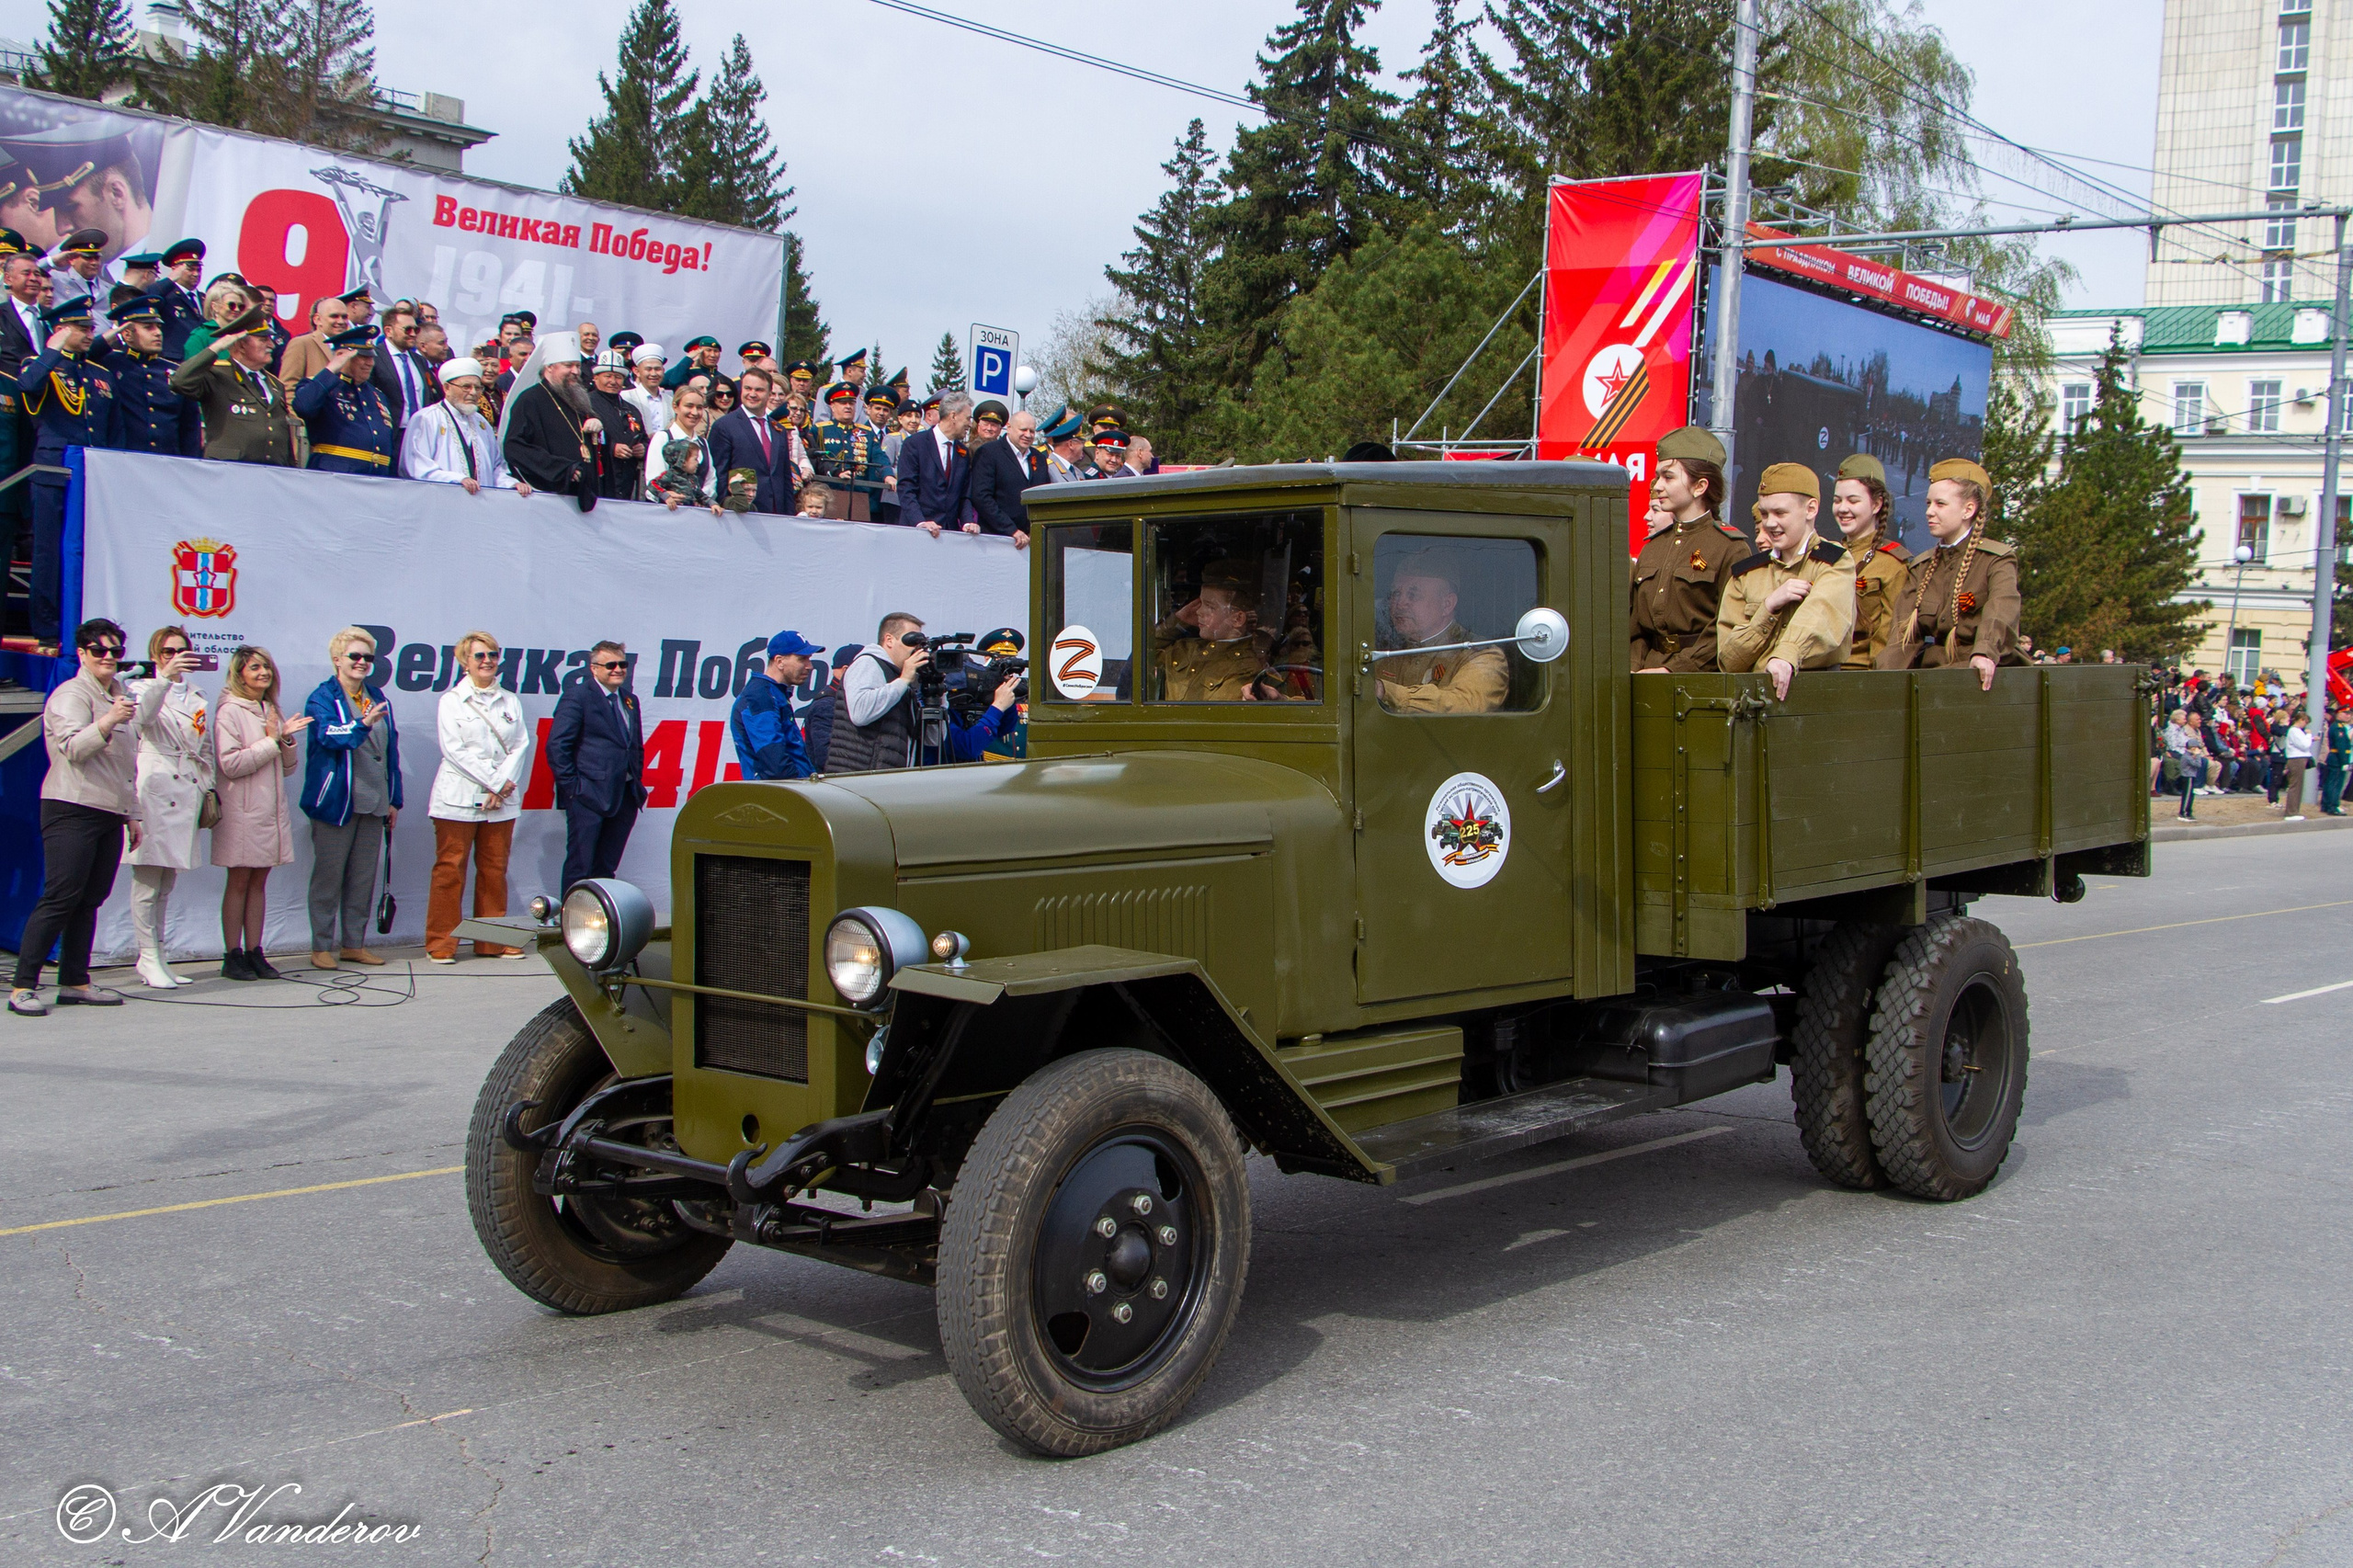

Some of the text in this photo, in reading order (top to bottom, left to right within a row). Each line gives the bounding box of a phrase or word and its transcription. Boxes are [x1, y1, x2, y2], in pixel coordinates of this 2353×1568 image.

[433, 194, 712, 274] Великая Победа!
[237, 188, 350, 338] 9
[1775, 246, 1782, 258] С
[1847, 264, 1894, 294] ВЕЛИКОЙ
[1905, 282, 1949, 311] ПОБЕДЫ!
[1974, 311, 1991, 325] МАЯ
[980, 330, 1009, 347] ЗОНА
[982, 351, 1003, 387] P
[188, 631, 244, 642] ительство
[1055, 638, 1099, 683] Z
[1460, 823, 1480, 838] 225
